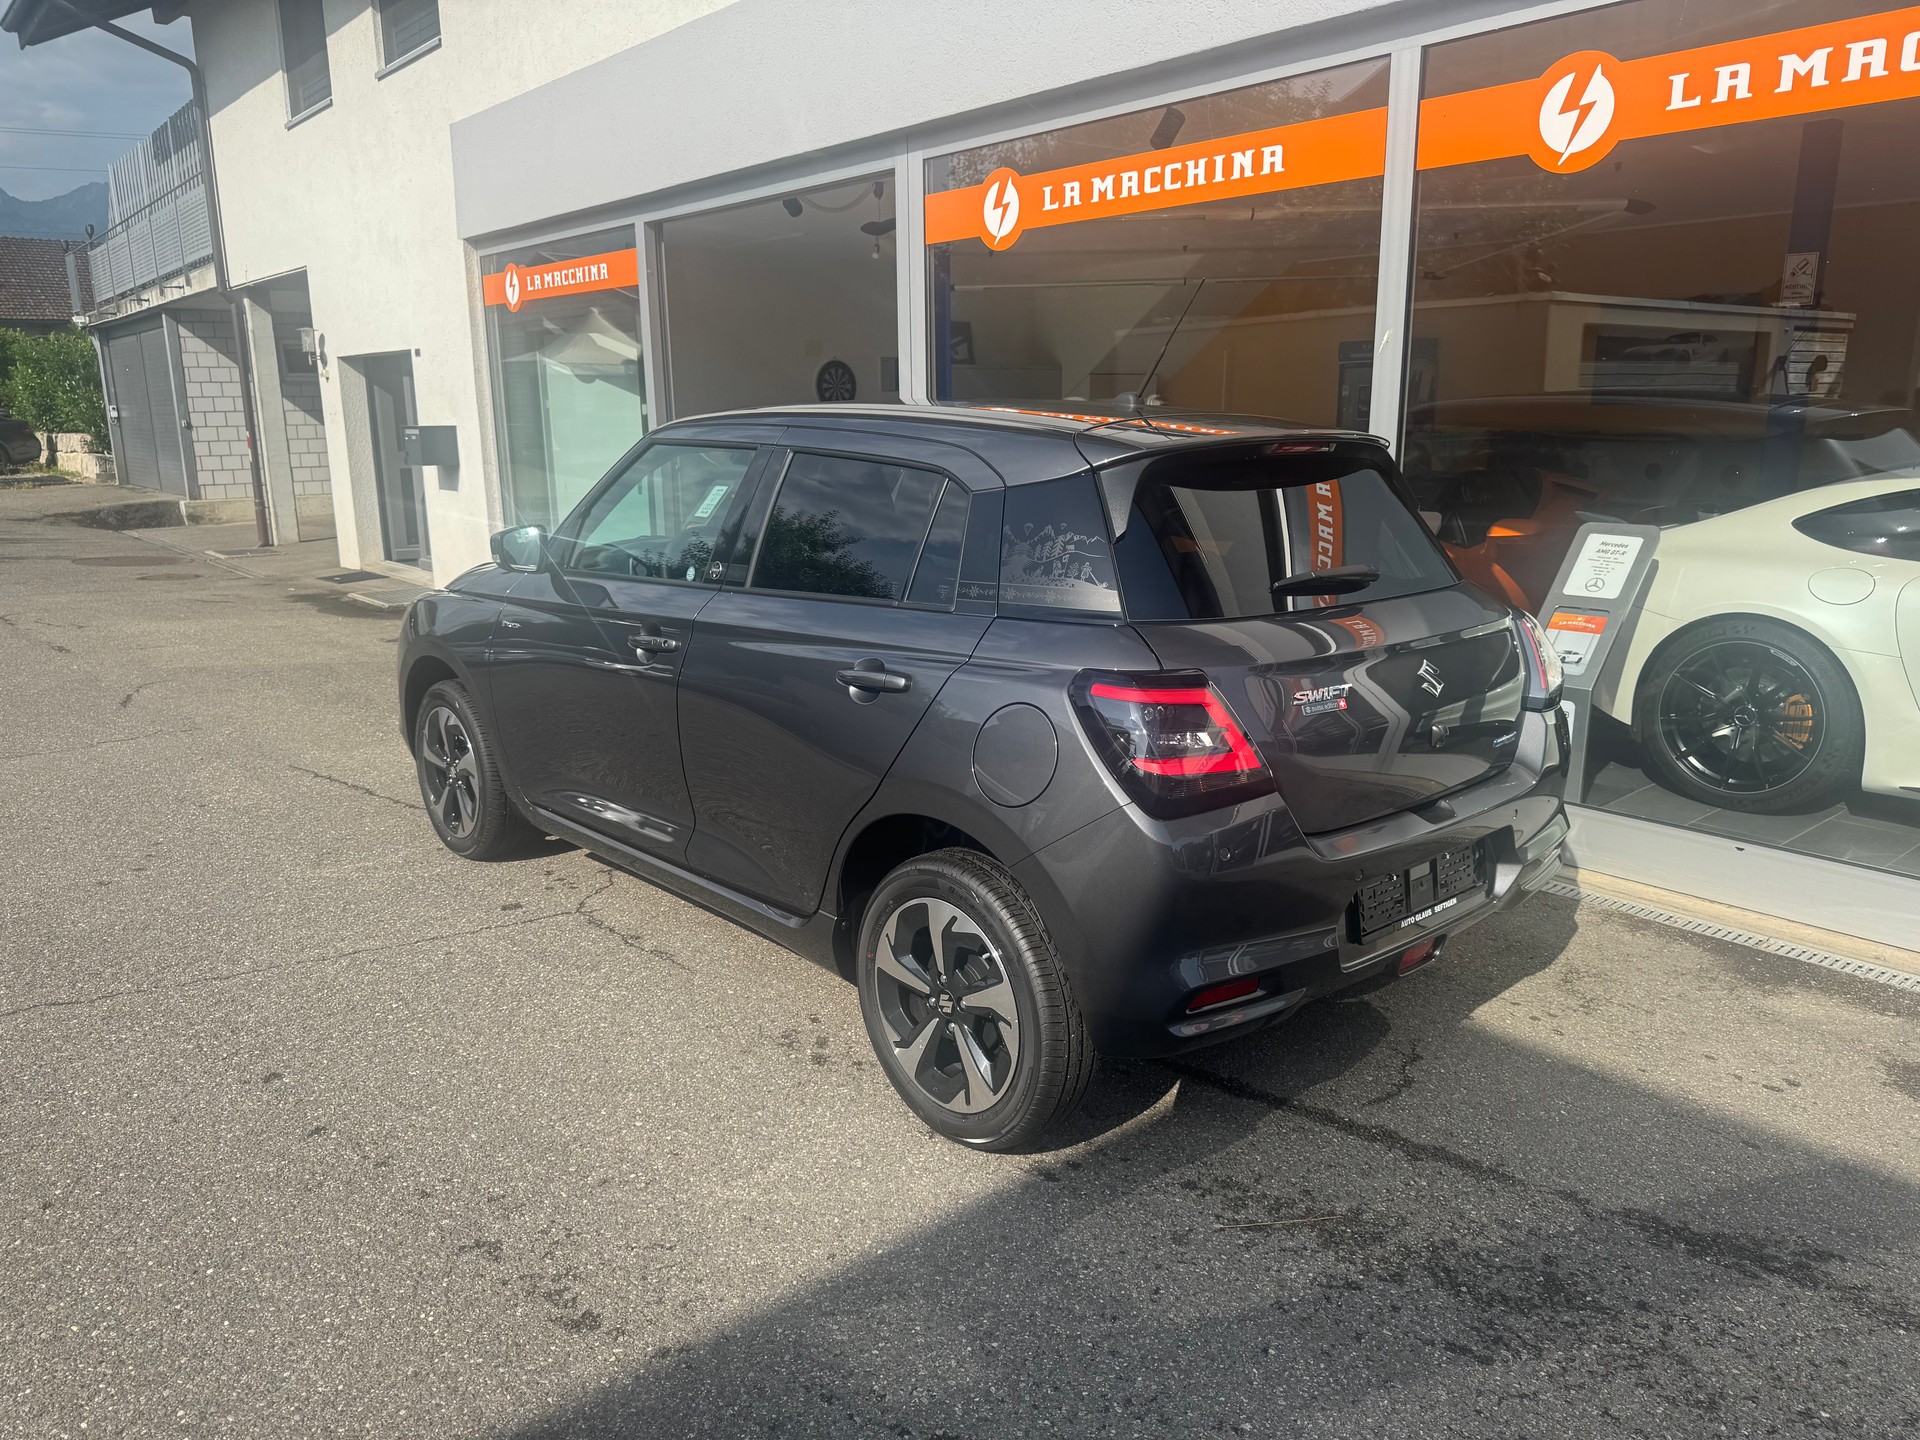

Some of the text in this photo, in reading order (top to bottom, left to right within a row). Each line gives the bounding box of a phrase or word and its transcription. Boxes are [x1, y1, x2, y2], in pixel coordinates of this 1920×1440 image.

[1665, 63, 1753, 111] LA
[1041, 144, 1285, 211] LA MACCHINA
[526, 262, 609, 291] LA MACCHINA
[1292, 683, 1353, 706] SWIFT
[1401, 897, 1457, 928] AUTO GLAUS SEFTIGEN
